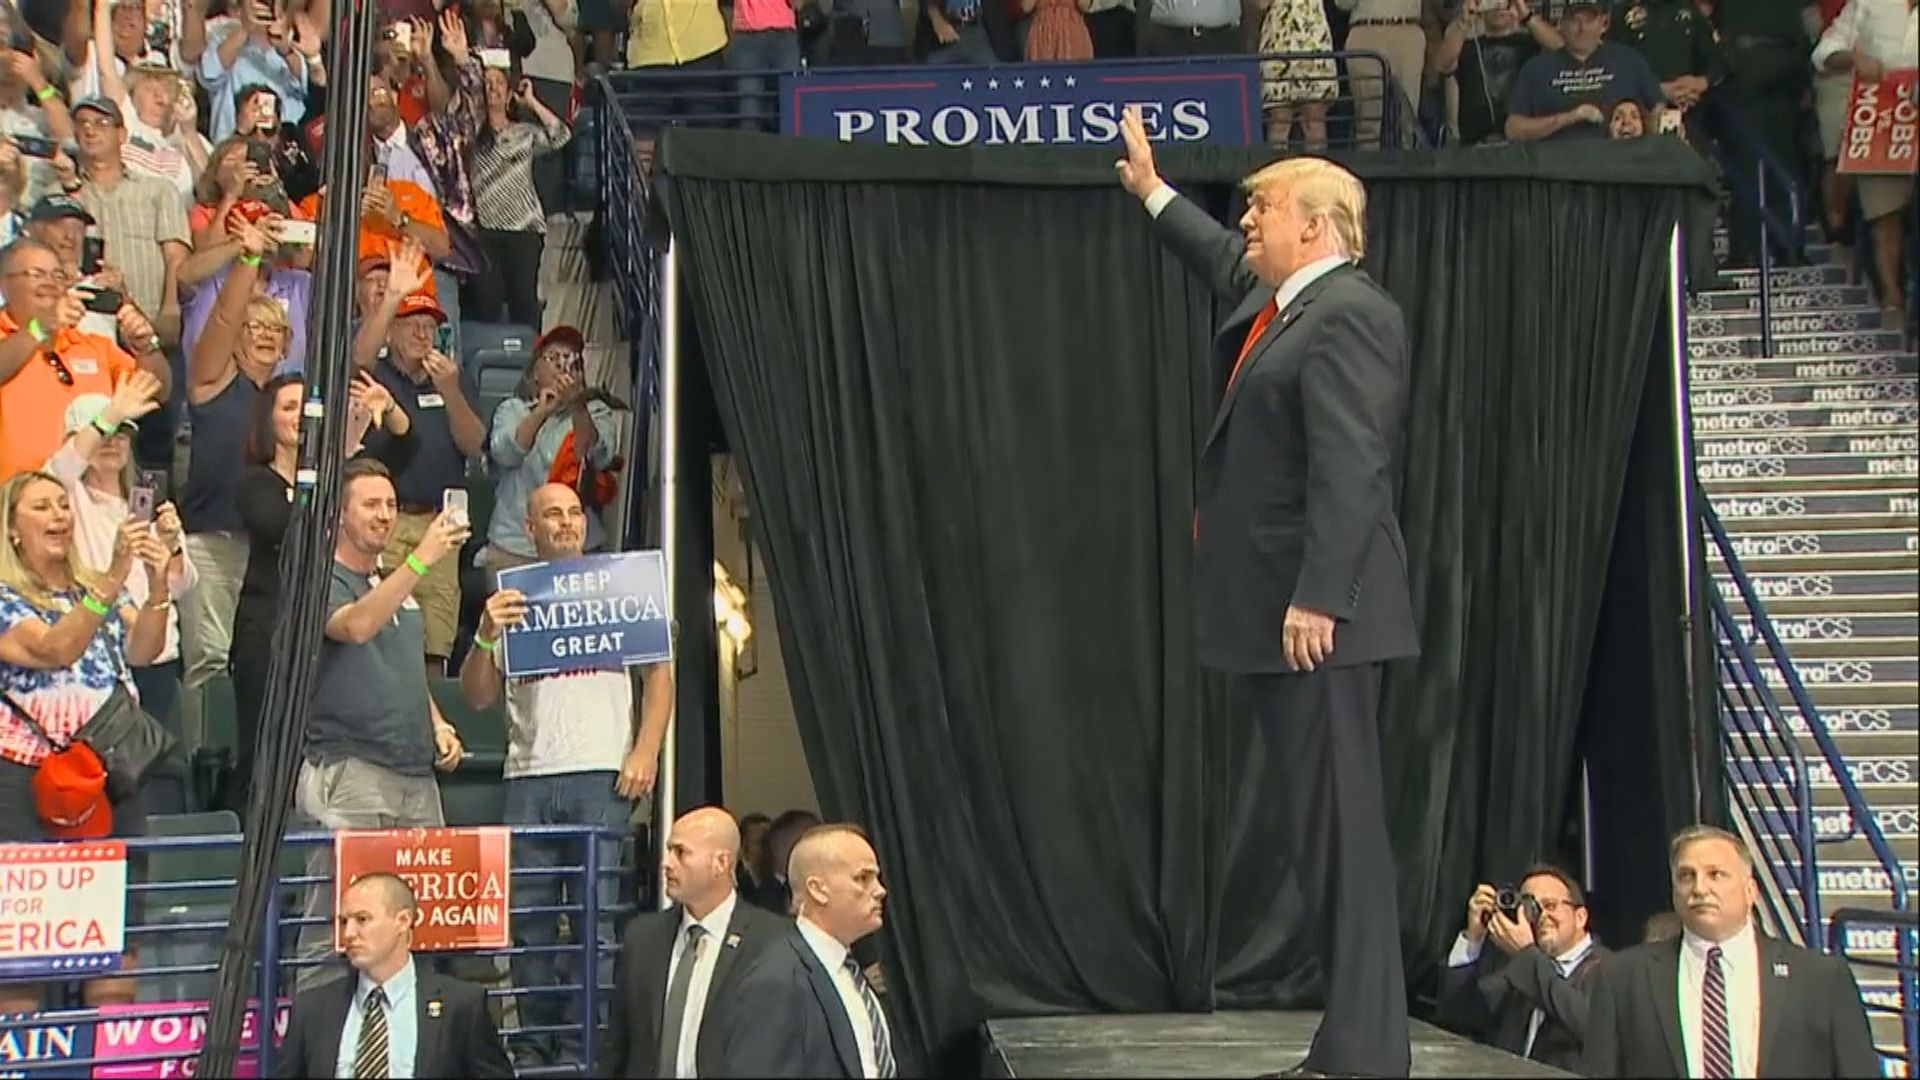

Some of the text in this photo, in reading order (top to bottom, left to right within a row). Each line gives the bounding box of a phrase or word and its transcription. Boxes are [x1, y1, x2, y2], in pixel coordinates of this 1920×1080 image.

[833, 100, 1210, 146] PROMISES
[1848, 83, 1879, 160] MOBS
[1887, 83, 1917, 160] JOBS
[1734, 269, 1824, 290] meroPCS
[1779, 334, 1876, 355] metroPCS
[1796, 357, 1897, 380] metroPCS
[1813, 381, 1915, 402] metroPCS
[1830, 406, 1918, 426] metroPC
[1703, 437, 1808, 457] metroPCS
[552, 570, 611, 595] KEEP
[1716, 576, 1833, 597] mtroPCS
[508, 595, 664, 634] AMERICA
[1738, 617, 1853, 639] mtroPCS
[551, 632, 625, 658] GREAT
[396, 848, 453, 866] MAKE
[0, 866, 94, 892] ND UP
[1, 898, 43, 916] FOR
[429, 905, 499, 928] AGAIN
